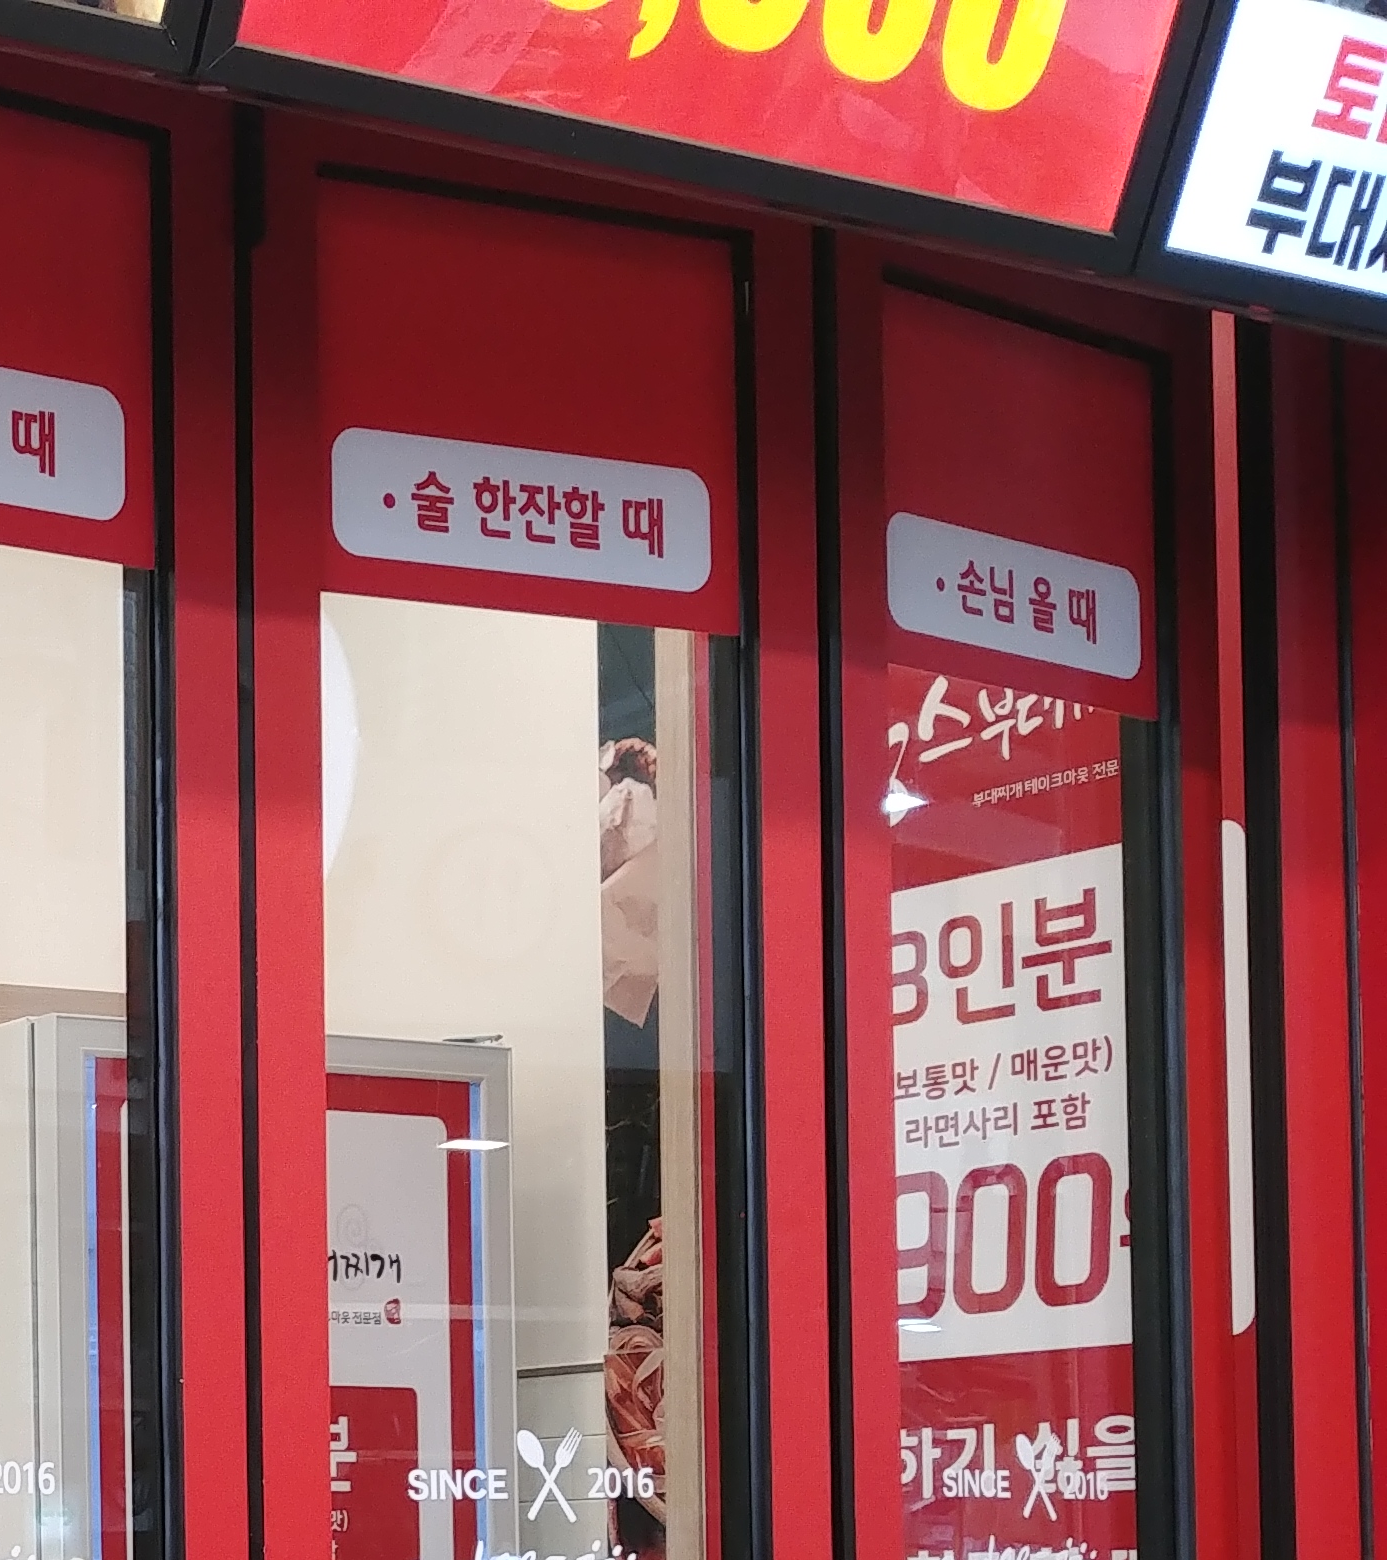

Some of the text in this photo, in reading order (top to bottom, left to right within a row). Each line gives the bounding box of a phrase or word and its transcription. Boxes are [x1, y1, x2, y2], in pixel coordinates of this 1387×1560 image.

[1311, 34, 1387, 145] 토
[11, 410, 57, 478] 때
[410, 470, 665, 559] 술 한잔할 때
[956, 559, 1098, 645] 손님 올 때
[971, 780, 1023, 809] 부대찌개
[1024, 768, 1089, 796] 테이크아웃
[1011, 1034, 1114, 1085] 매운맛)
[904, 1091, 1092, 1150] 라면사리 포함
[895, 1151, 1131, 1319] 900
[407, 1466, 655, 1502] SINCE 2016
[942, 1467, 1109, 1501] SINCE 2016
